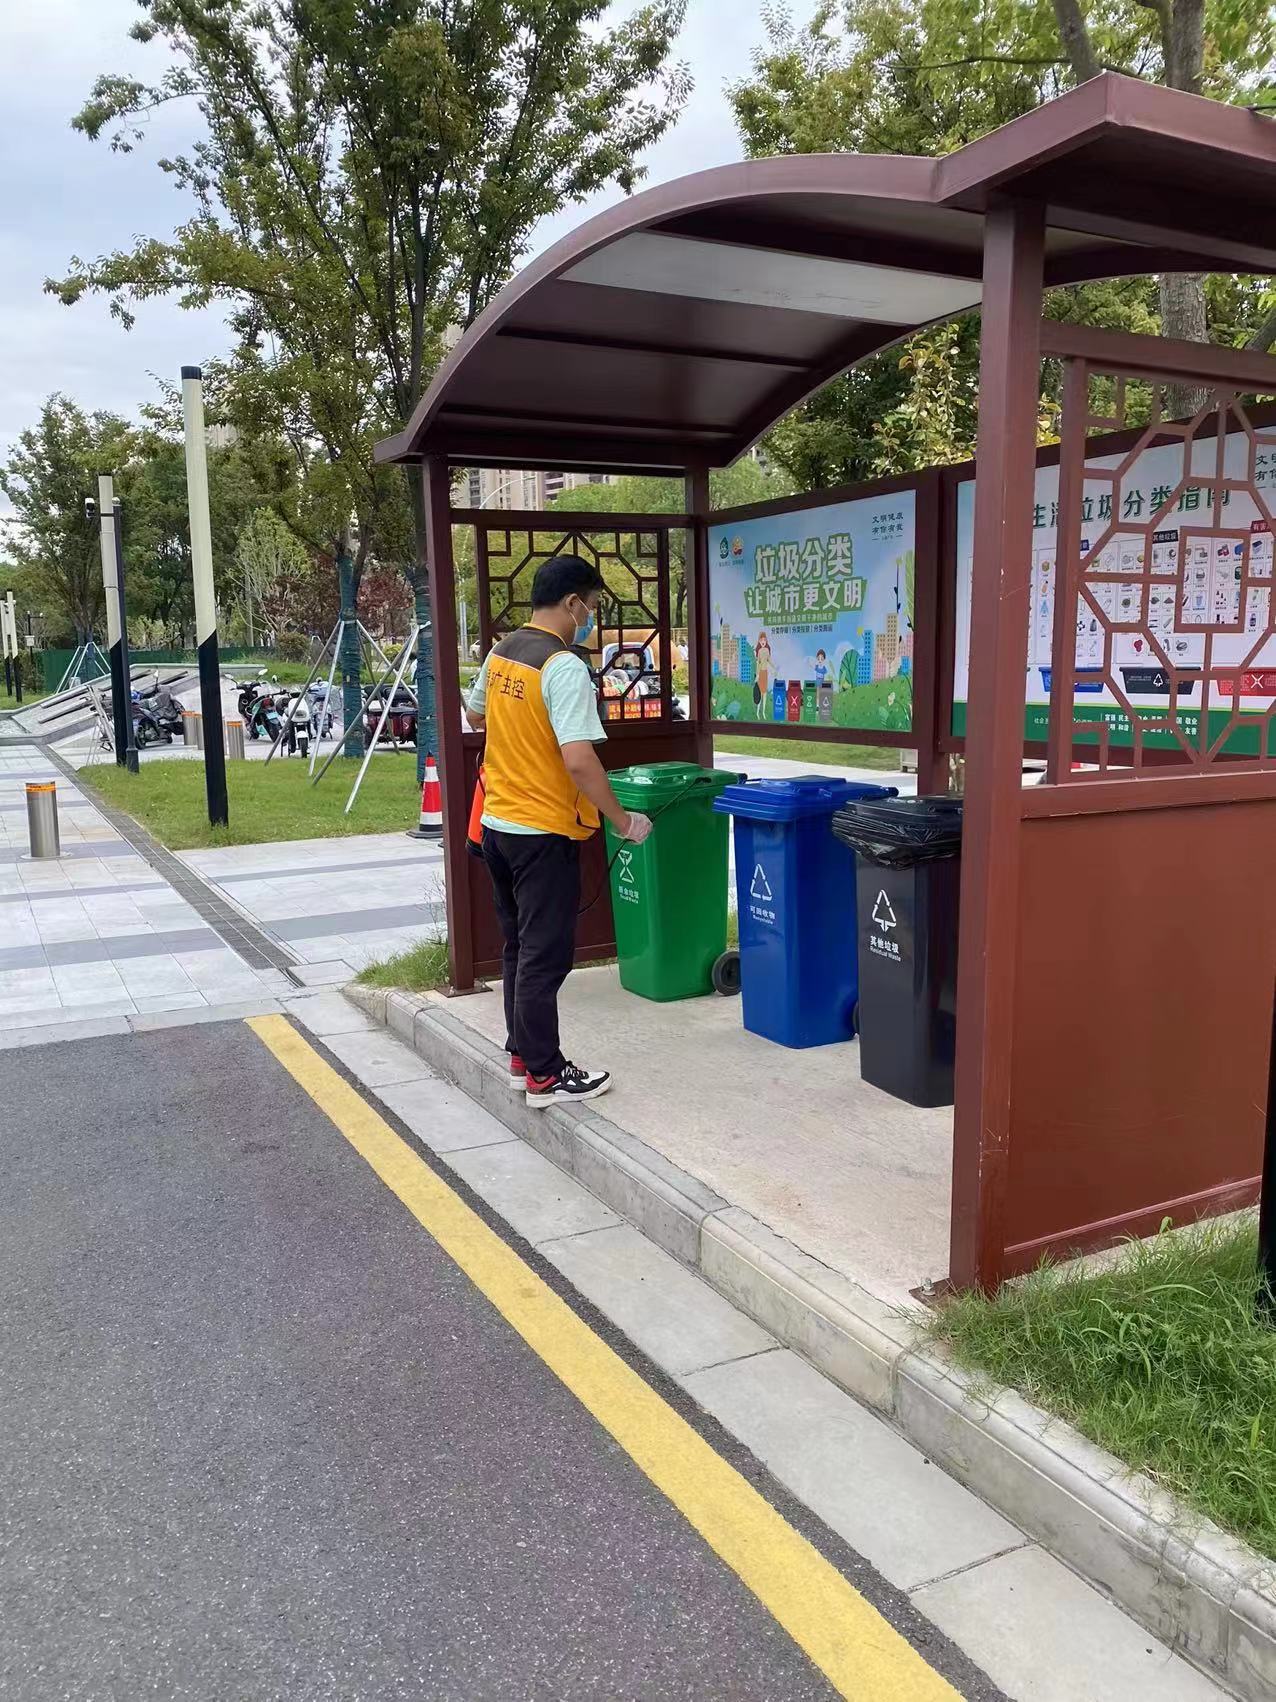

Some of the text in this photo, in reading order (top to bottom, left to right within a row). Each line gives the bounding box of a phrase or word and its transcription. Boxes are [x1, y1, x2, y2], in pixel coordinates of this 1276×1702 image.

[1152, 531, 1177, 543] 其他垃圾
[755, 534, 852, 583] 垃圾分类
[746, 579, 863, 615] 让城市更文明
[750, 905, 776, 920] 可回收物
[870, 935, 899, 954] 其他垃圾
